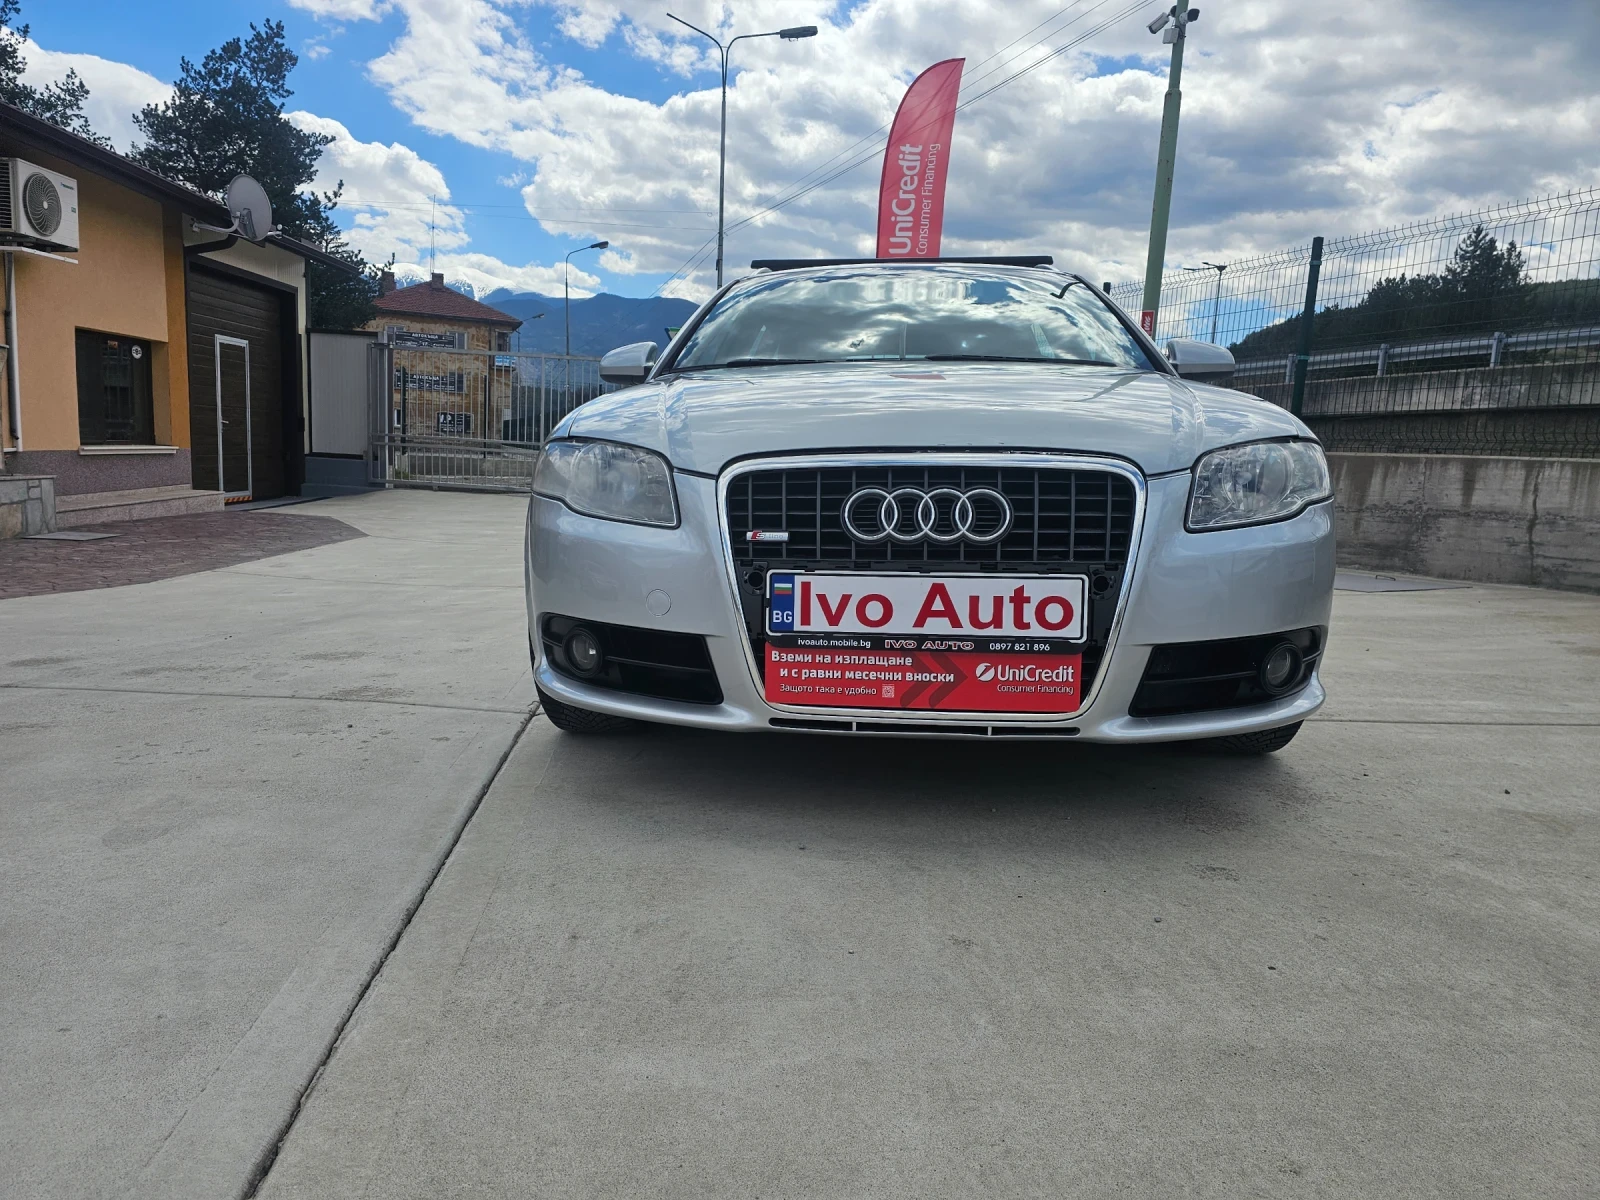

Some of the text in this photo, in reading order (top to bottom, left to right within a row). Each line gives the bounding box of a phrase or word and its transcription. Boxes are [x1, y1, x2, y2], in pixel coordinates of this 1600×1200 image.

[889, 143, 923, 255] UniCredit
[916, 143, 941, 255] Consumer Financing
[800, 581, 1075, 631] Ivo Auto
[772, 610, 793, 623] BG
[797, 637, 872, 649] ivoauto.mobile.bg
[884, 639, 975, 651] IVO AUTO
[989, 642, 1050, 652] 0897 821 896
[771, 650, 913, 667] Вземи на изплащане
[780, 668, 955, 682] и с равни месечни вноски
[997, 664, 1075, 682] UniCredit
[779, 683, 813, 694] Защото
[815, 685, 835, 694] така
[844, 686, 877, 697] удобно
[997, 684, 1074, 696] Consumer Financing
